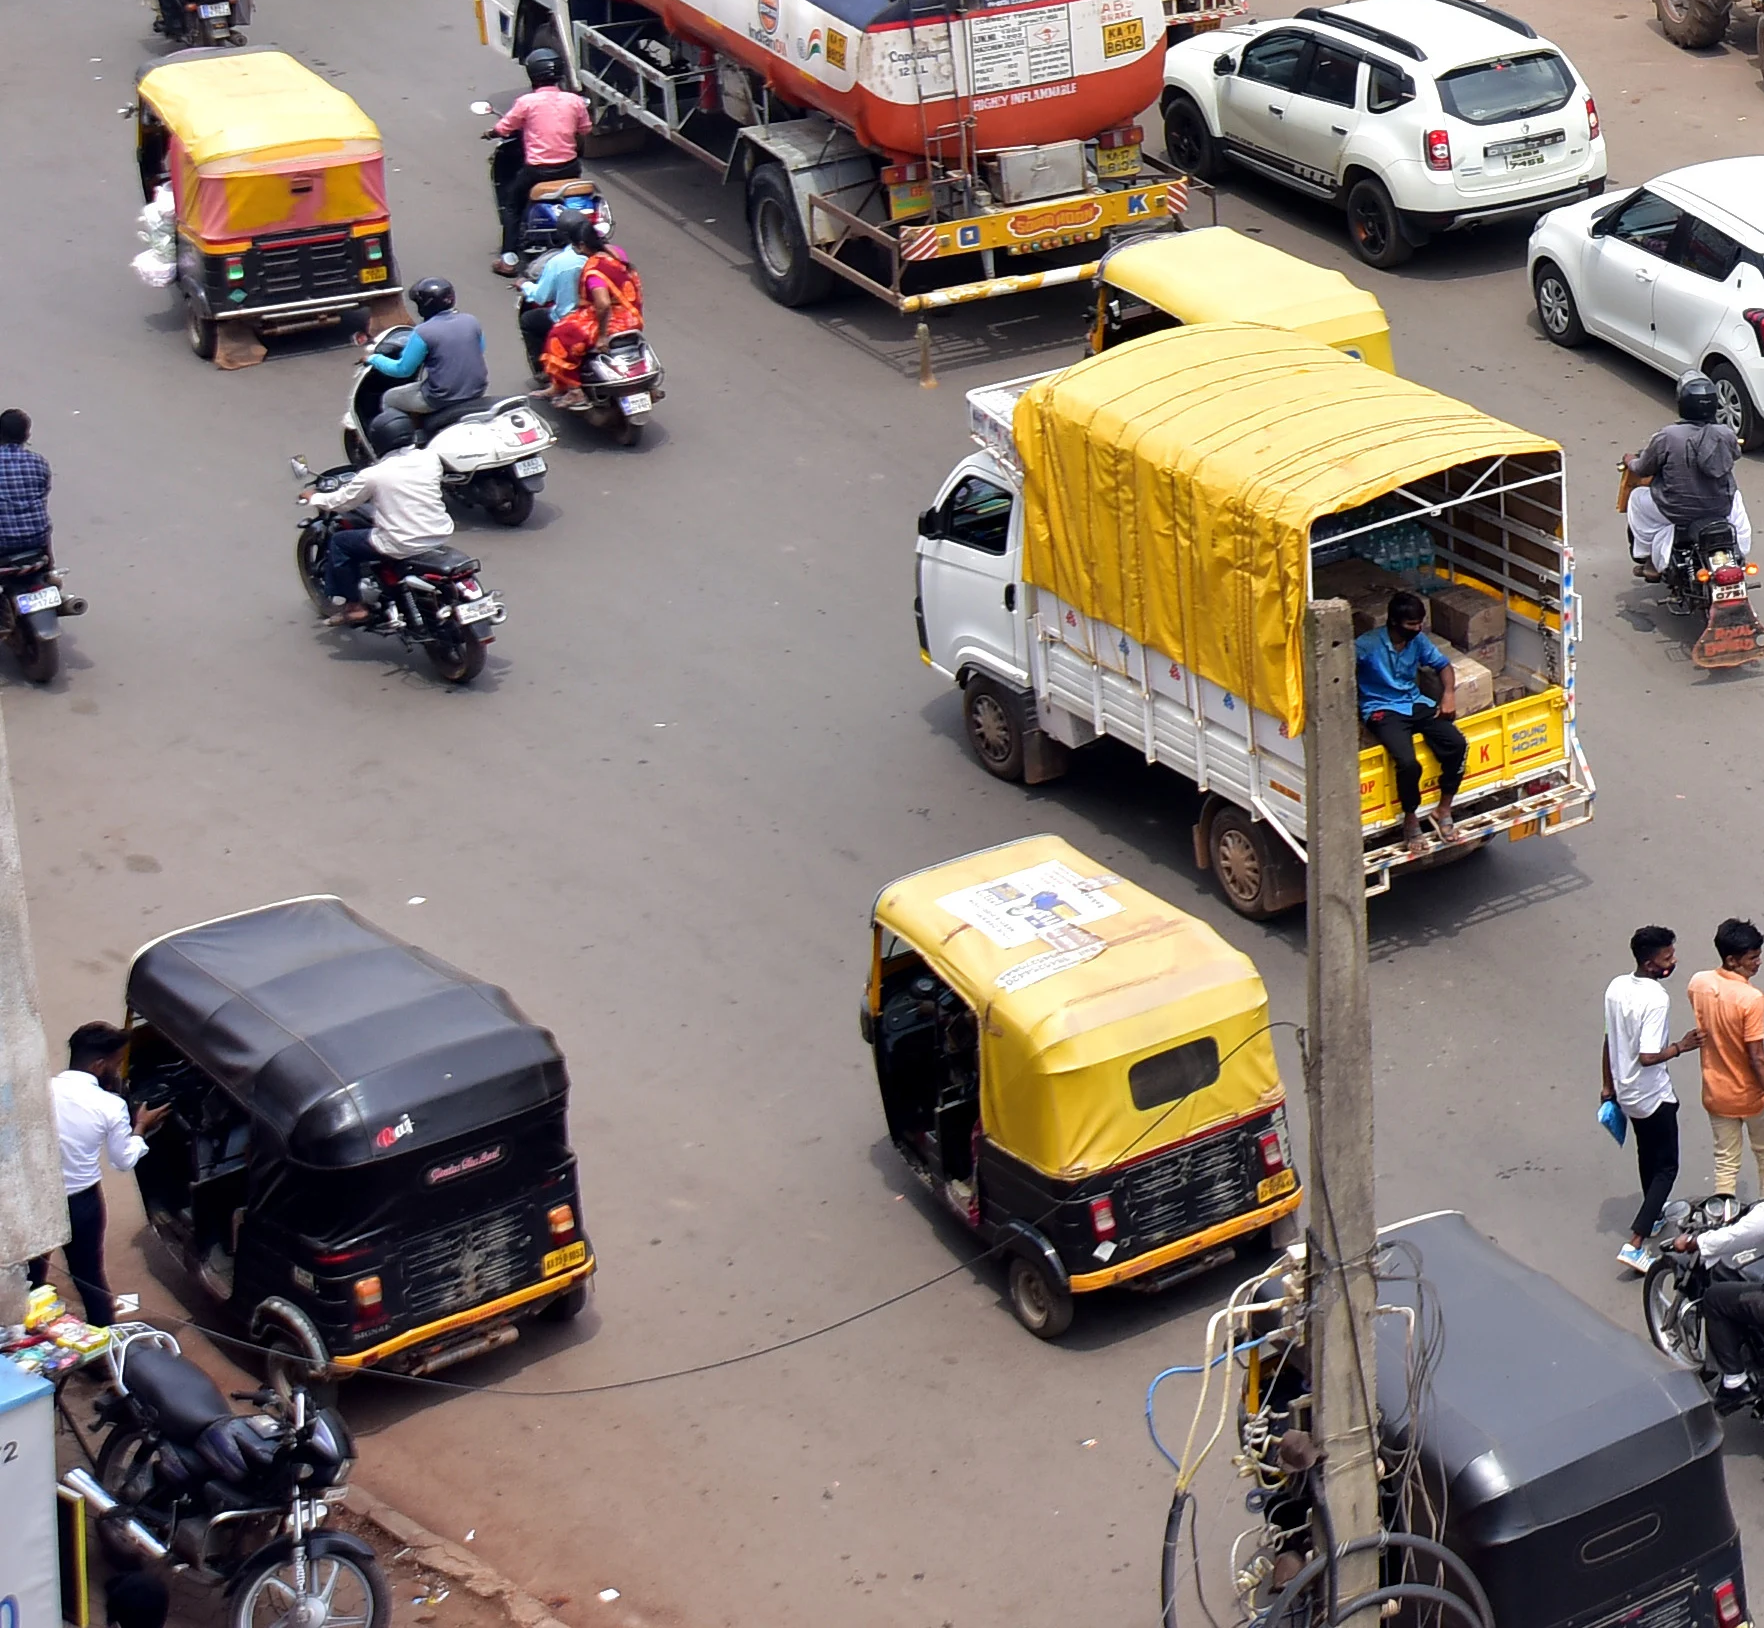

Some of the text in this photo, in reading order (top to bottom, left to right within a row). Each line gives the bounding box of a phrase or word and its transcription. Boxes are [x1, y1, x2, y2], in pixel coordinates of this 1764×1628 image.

[1101, 10, 1133, 23] BRAKE
[1108, 24, 1138, 39] KA 17
[1105, 36, 1143, 55] B6132
[972, 82, 1078, 112] HIGHLY INFLAMMABLE
[1487, 134, 1566, 157] DUSTER
[1479, 722, 1548, 765] K SOUND
[1511, 733, 1549, 755] HORN
